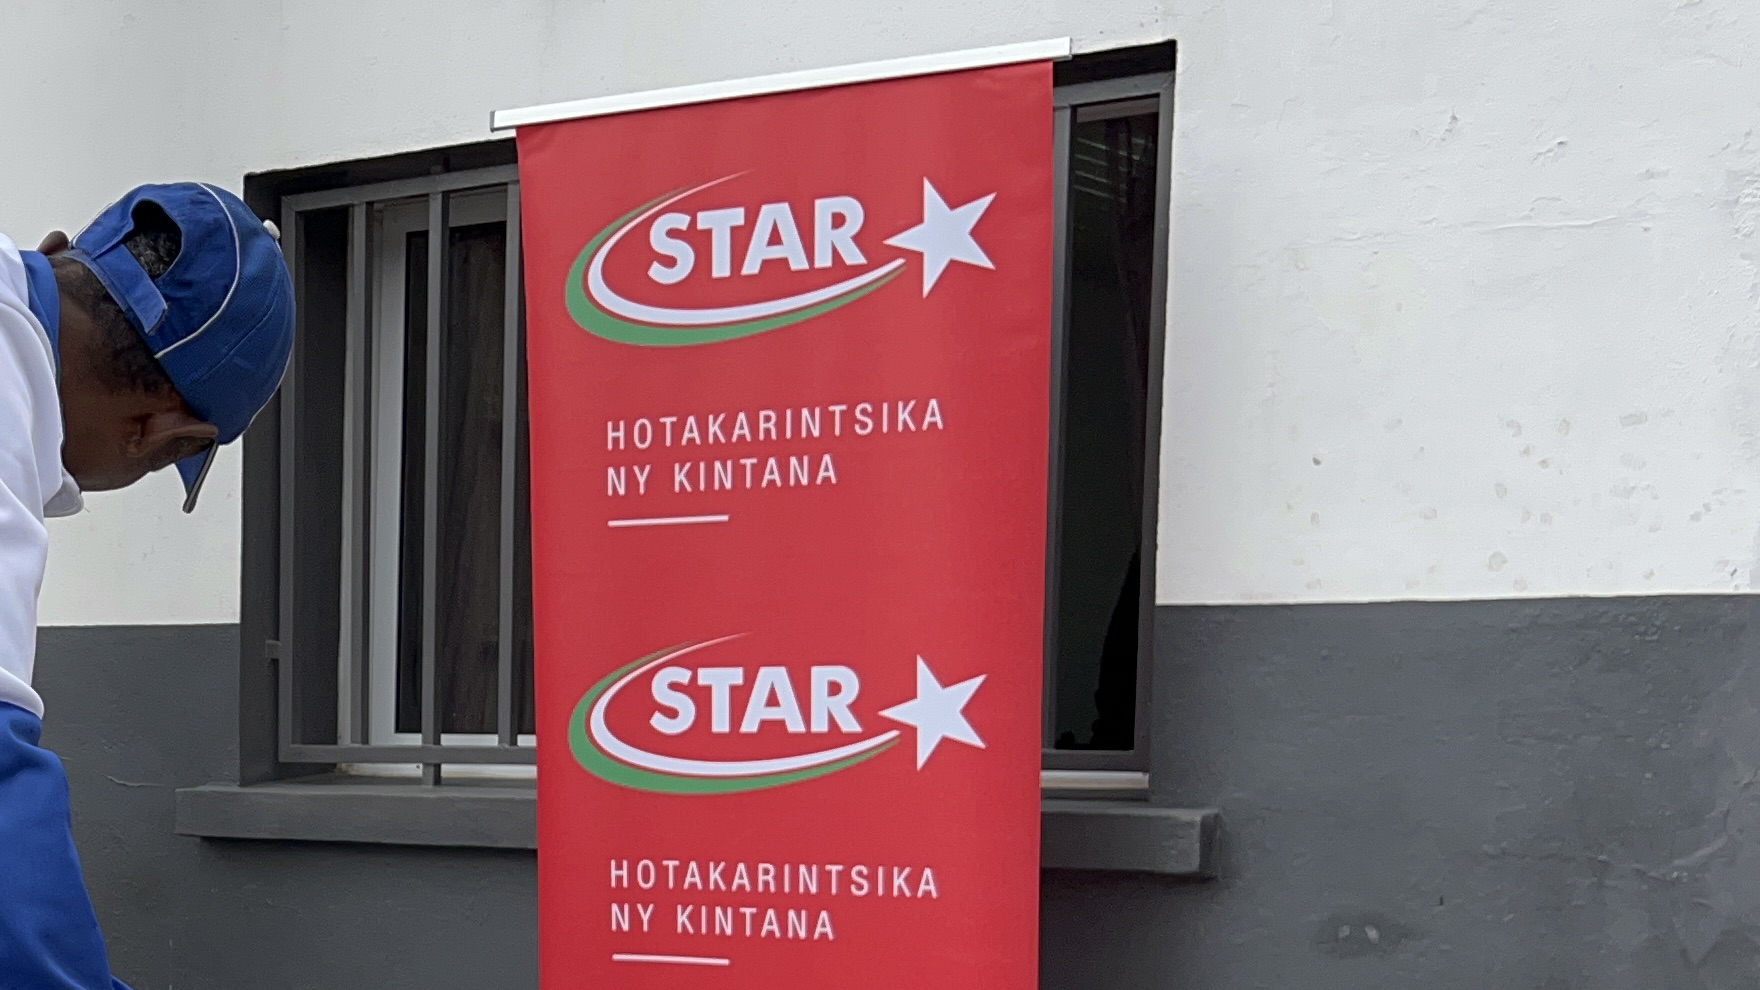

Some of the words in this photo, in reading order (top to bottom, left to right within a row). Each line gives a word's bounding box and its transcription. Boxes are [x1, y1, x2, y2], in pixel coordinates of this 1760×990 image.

[648, 196, 867, 285] STAR
[607, 398, 943, 451] HOTAKARINTSIKA
[607, 464, 651, 496] NY
[675, 453, 837, 493] KINTANA
[650, 665, 863, 735] STAR
[610, 859, 938, 899] HOTAKARINTSIKA
[610, 903, 654, 932] NY
[677, 904, 835, 941] KINTANA
